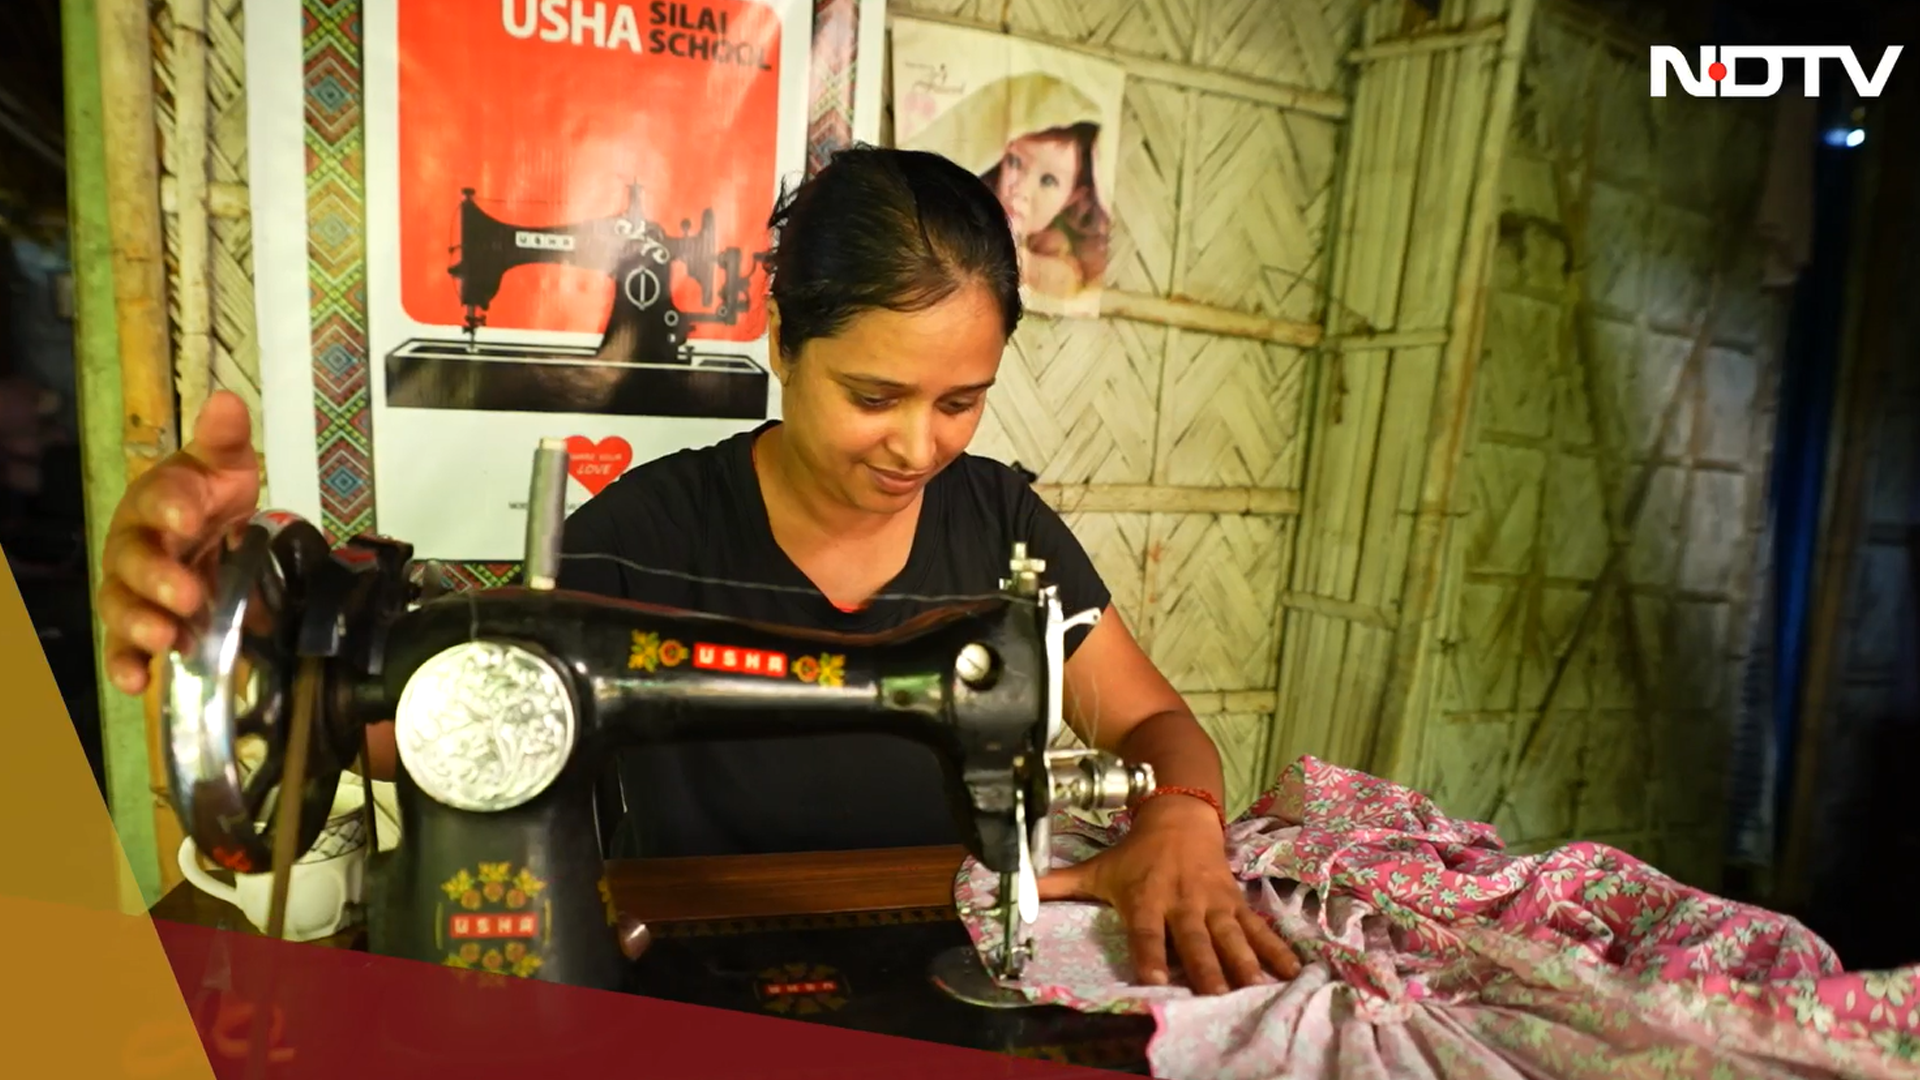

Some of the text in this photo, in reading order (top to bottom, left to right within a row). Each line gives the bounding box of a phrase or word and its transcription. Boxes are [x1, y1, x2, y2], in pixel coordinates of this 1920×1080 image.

[502, 0, 643, 54] USHA
[650, 1, 728, 35] SILAI
[649, 29, 771, 71] SCHOOL
[576, 463, 612, 476] LOVE
[698, 647, 784, 673] USHA
[454, 915, 534, 934] USHA
